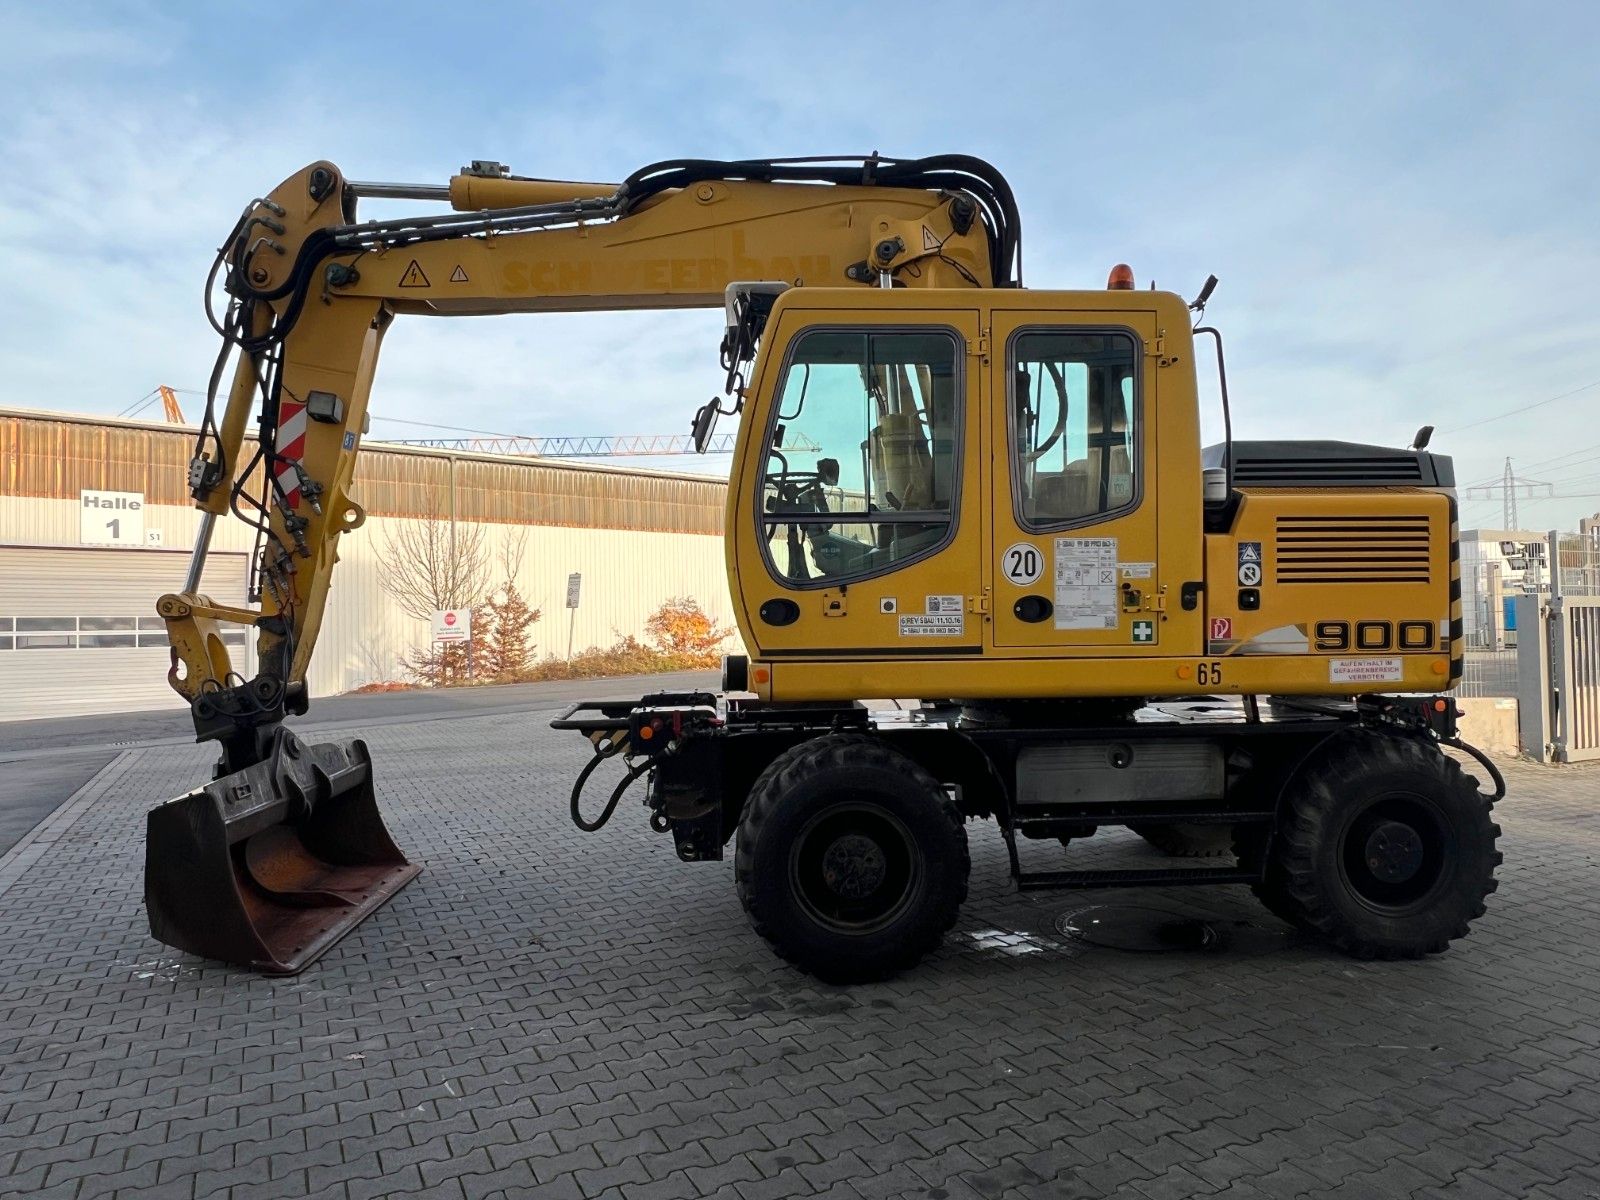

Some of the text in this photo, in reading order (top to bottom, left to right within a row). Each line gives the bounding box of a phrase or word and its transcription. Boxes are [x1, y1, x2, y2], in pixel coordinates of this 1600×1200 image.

[83, 495, 141, 510] Halle
[106, 519, 120, 538] 1
[1010, 550, 1036, 577] 20
[1314, 620, 1435, 652] 900
[1197, 662, 1222, 686] 65
